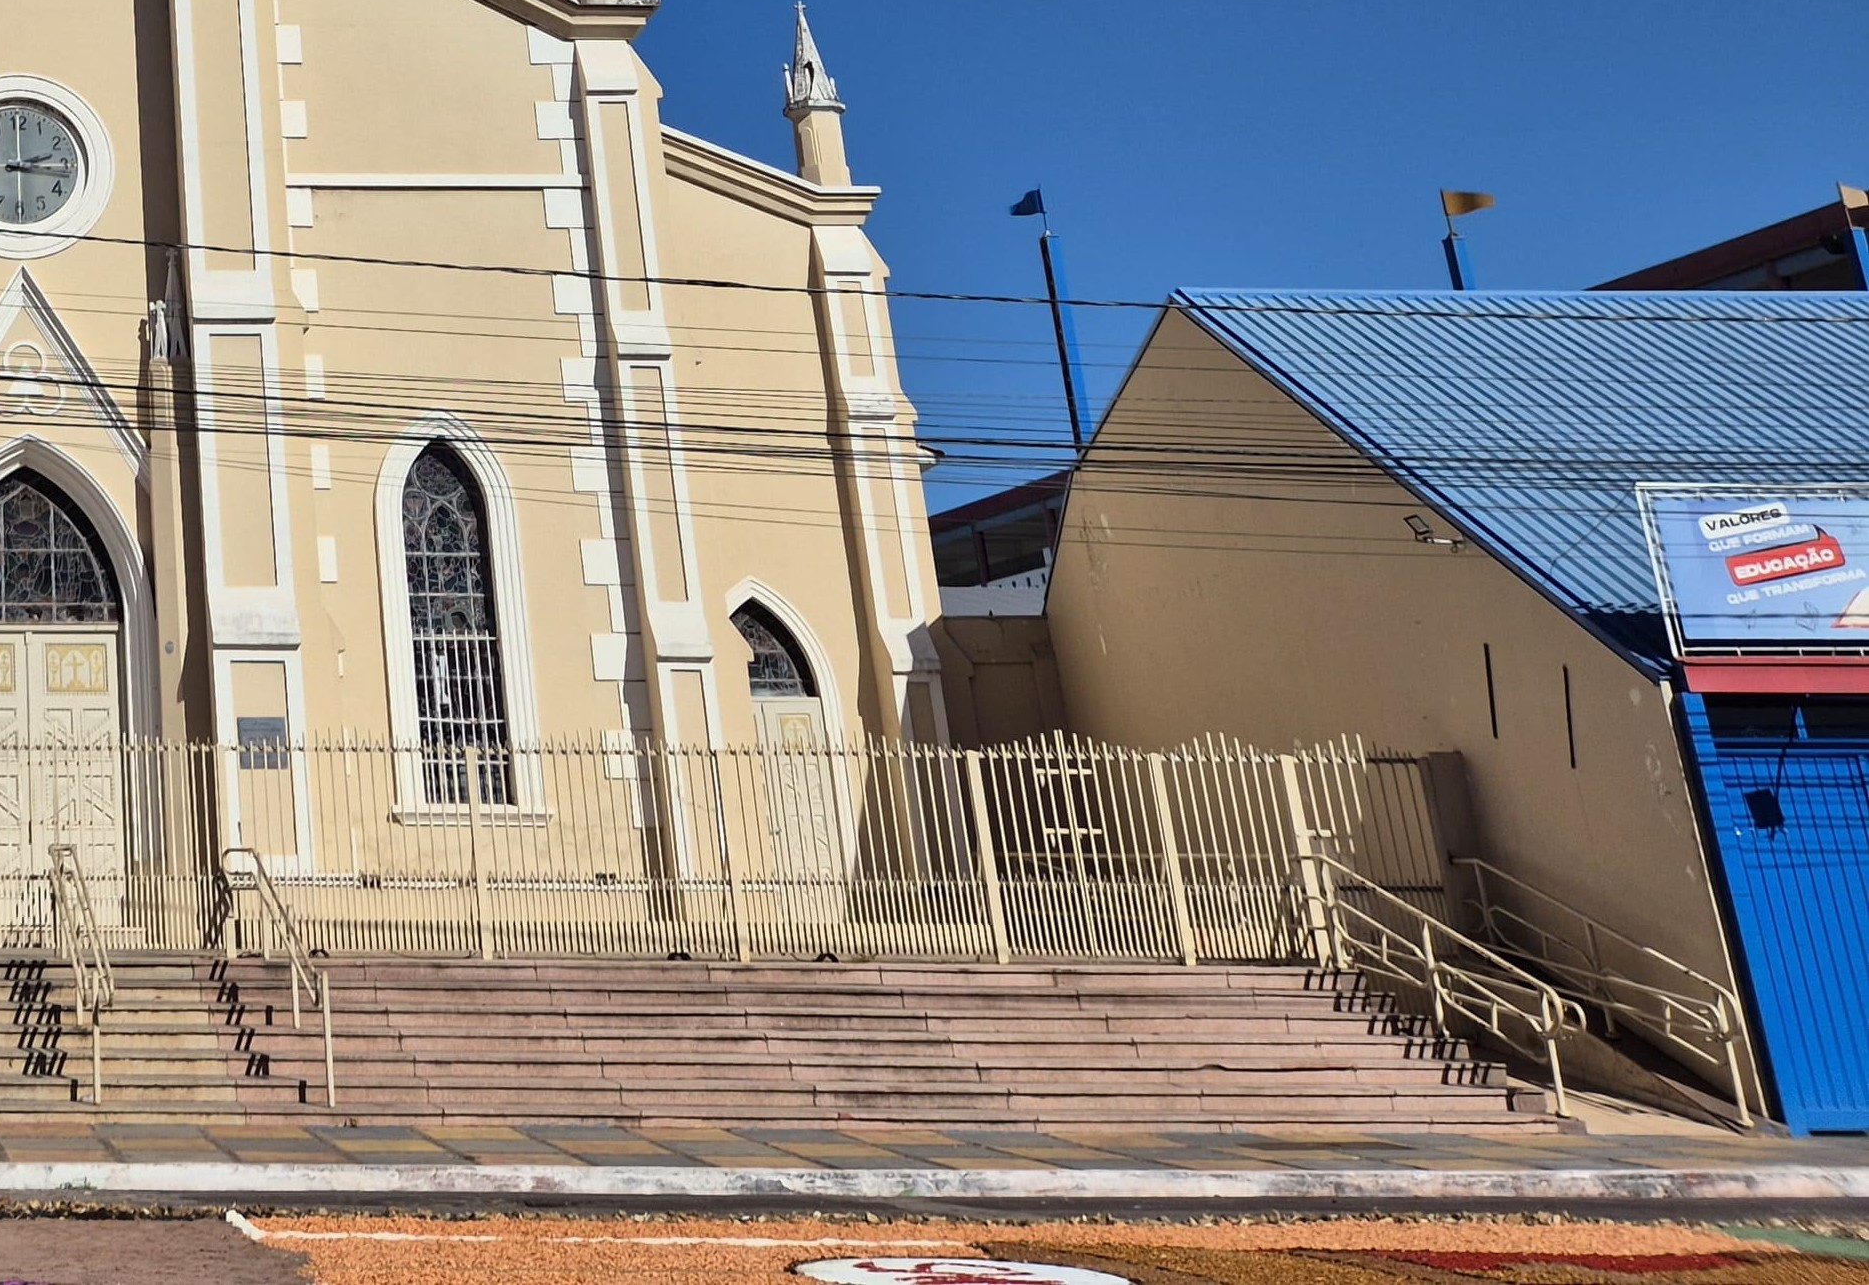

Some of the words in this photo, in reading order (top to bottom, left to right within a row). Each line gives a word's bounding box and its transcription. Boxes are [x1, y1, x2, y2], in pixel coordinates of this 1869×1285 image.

[10, 115, 27, 131] 12
[36, 121, 42, 135] 1
[52, 135, 61, 151] 2
[60, 157, 69, 172] 3
[51, 179, 62, 197] 4
[15, 200, 25, 217] 6
[36, 195, 46, 211] 5
[1705, 508, 1782, 532] VALORES
[1708, 537, 1741, 553] QUE
[1744, 523, 1811, 546] FORMAM
[1733, 547, 1836, 580] EDUCAÇÃO
[1726, 589, 1760, 605] QUE
[1761, 568, 1867, 598] TRANSFORMA
